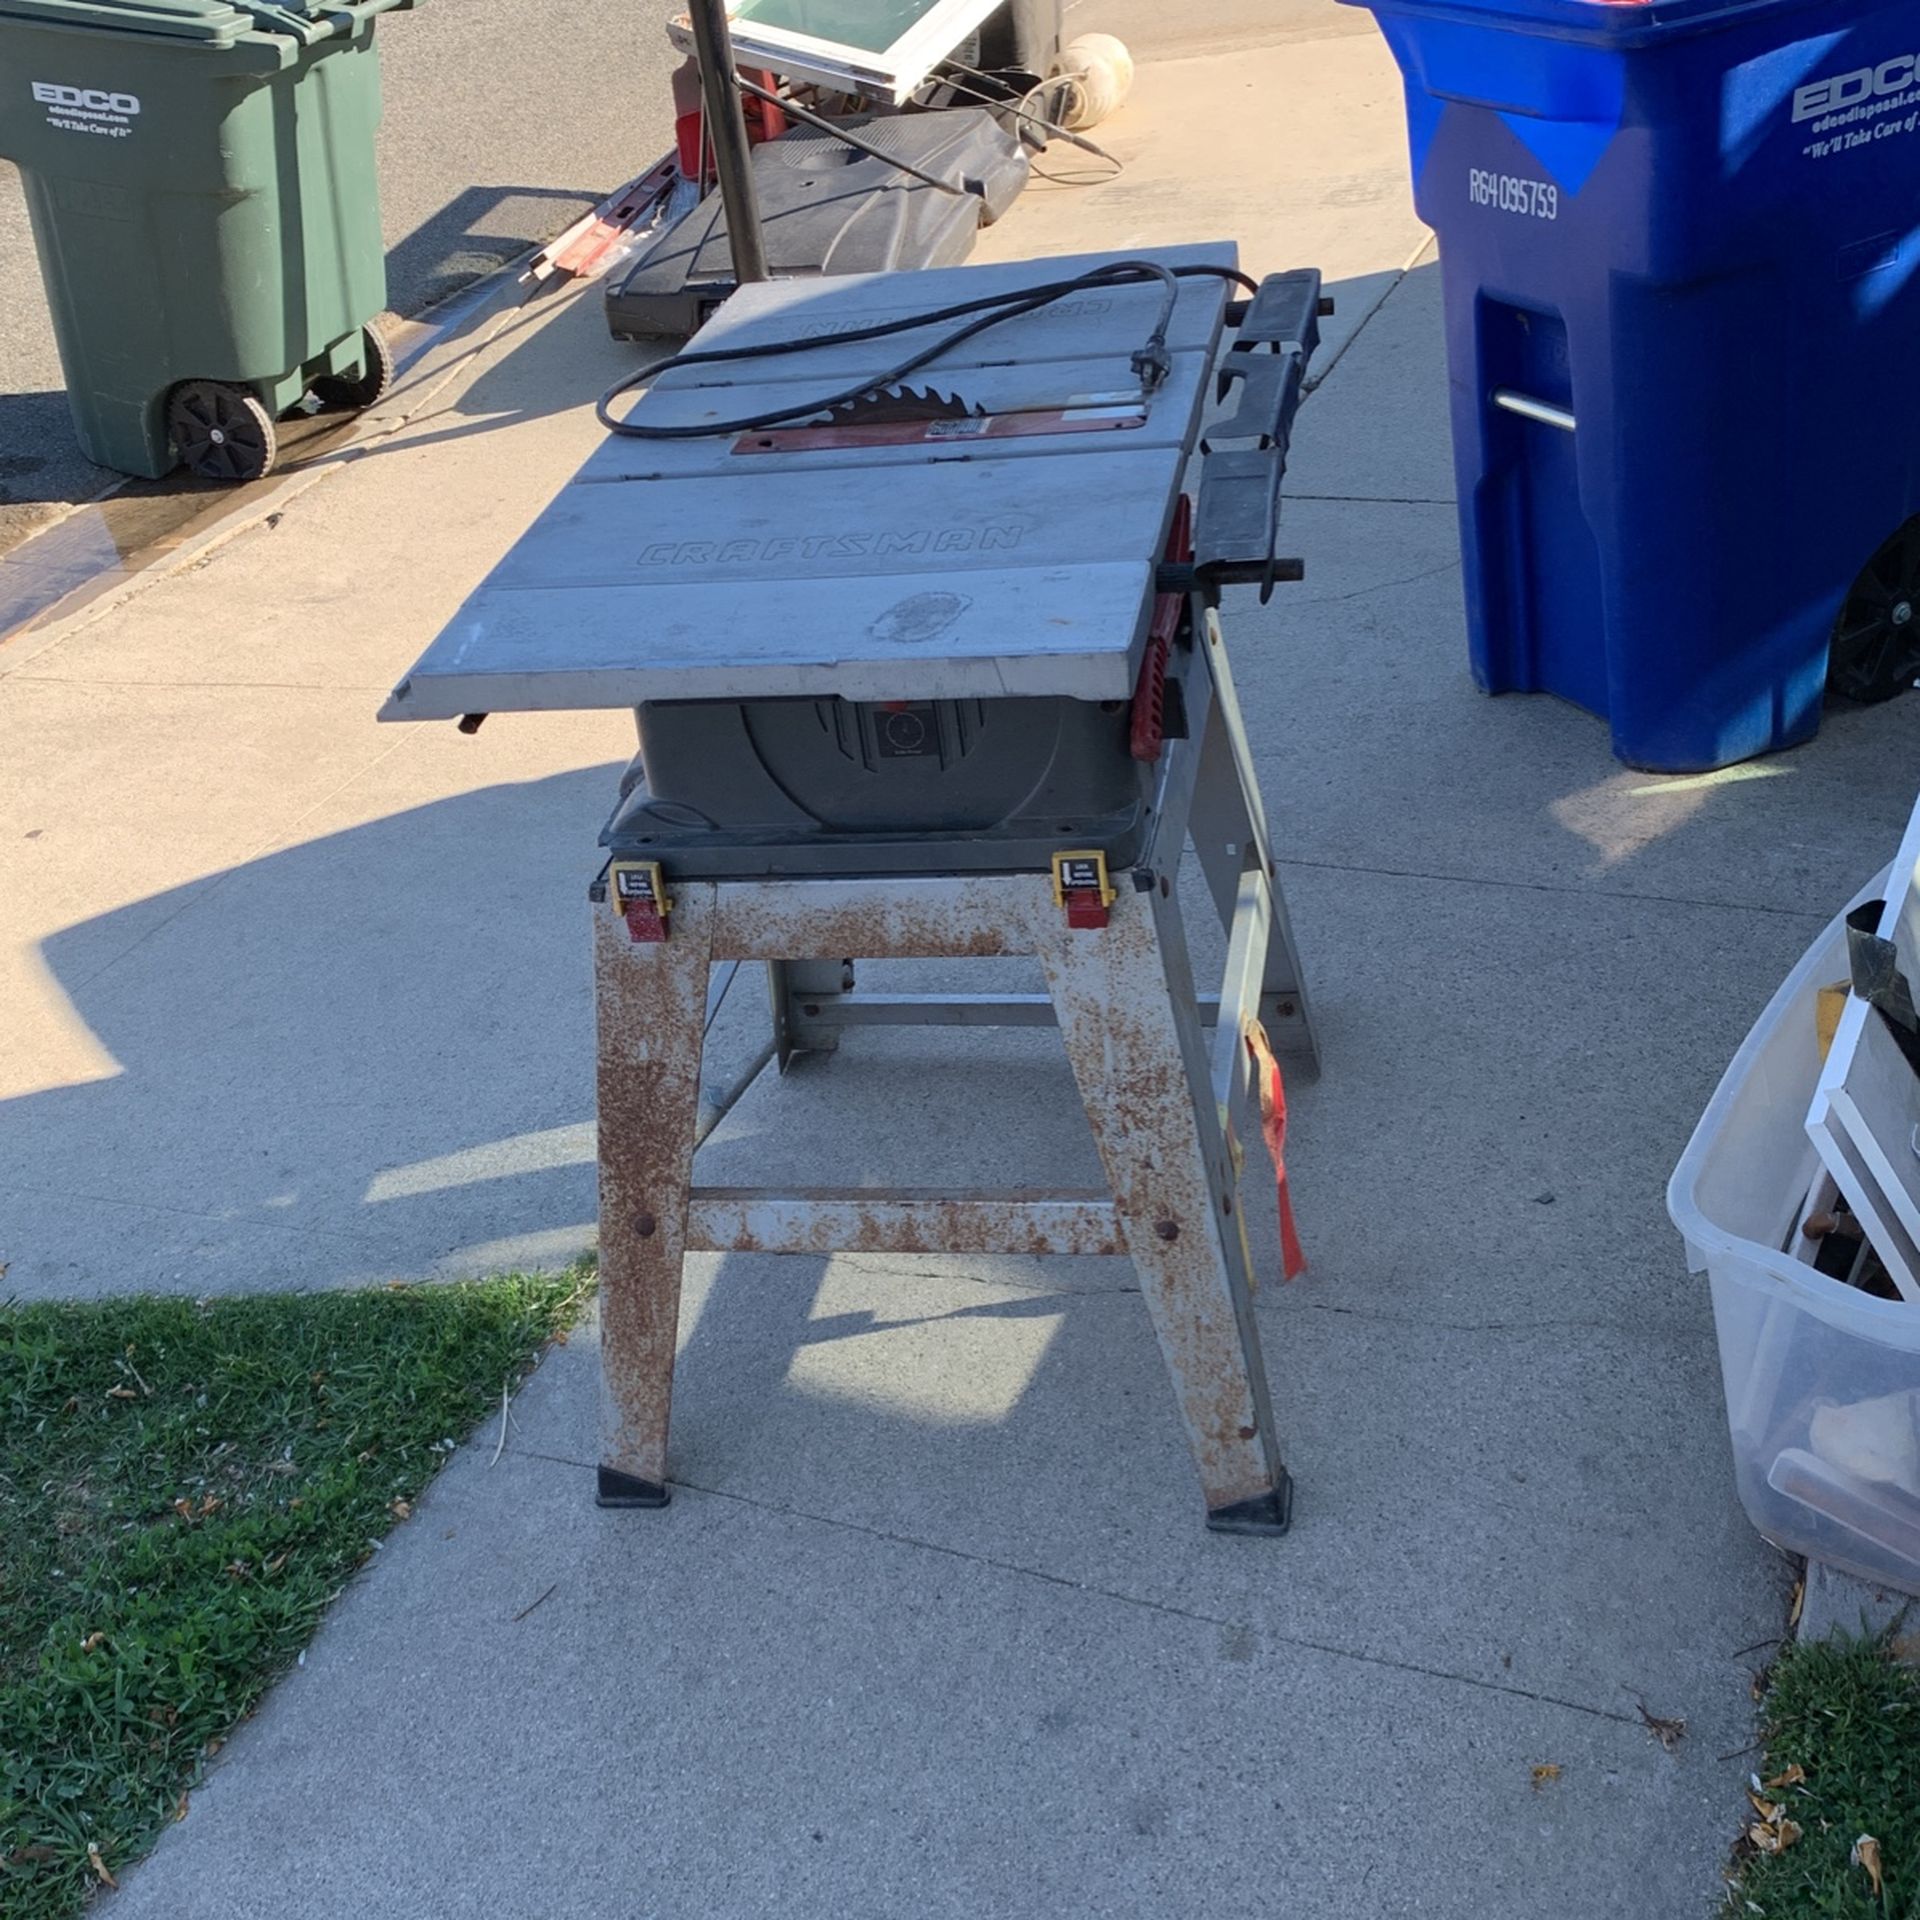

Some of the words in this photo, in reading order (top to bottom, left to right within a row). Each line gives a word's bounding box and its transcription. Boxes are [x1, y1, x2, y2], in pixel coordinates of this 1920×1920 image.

[31, 81, 141, 115] EDCO
[1791, 52, 1920, 123] EDC
[1844, 129, 1872, 150] Take
[1874, 119, 1902, 139] Care
[1904, 111, 1920, 132] of
[636, 525, 1024, 566] CRAFTSMAN
